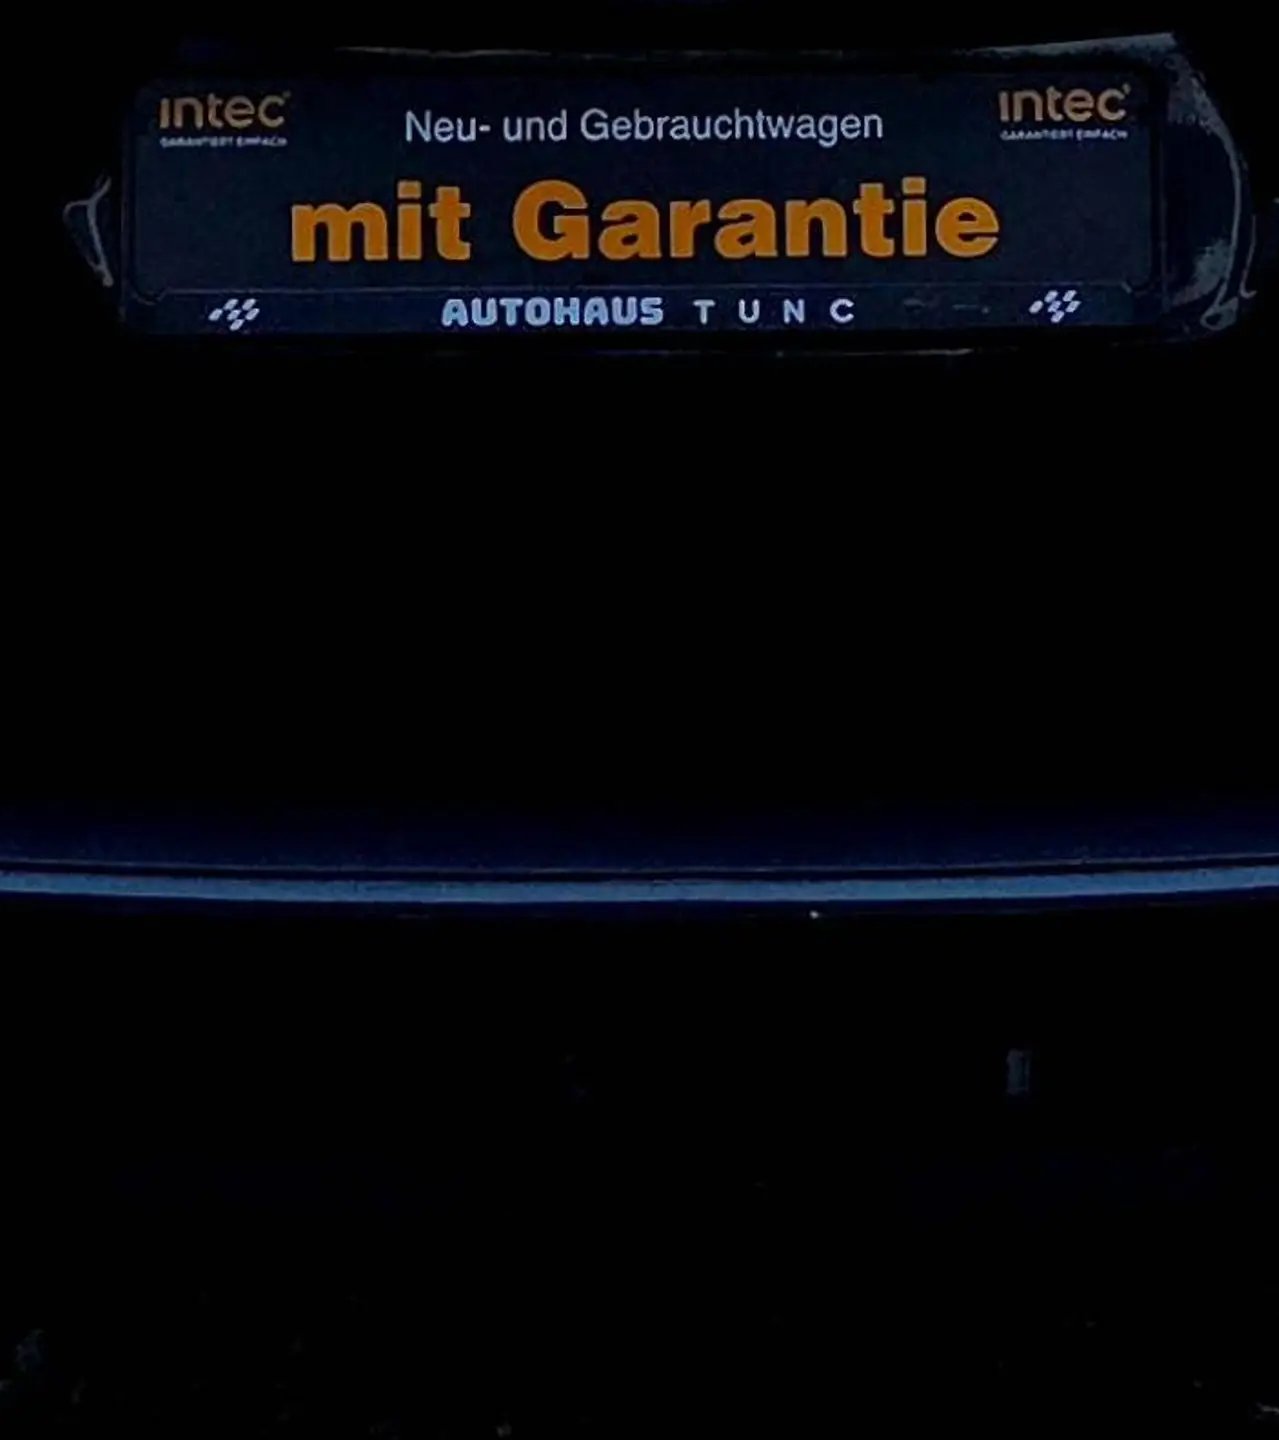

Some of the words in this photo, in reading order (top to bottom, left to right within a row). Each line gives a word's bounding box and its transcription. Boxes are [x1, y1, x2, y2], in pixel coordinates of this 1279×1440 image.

[159, 93, 287, 130] intec
[998, 85, 1127, 122] intec
[405, 110, 490, 142] Neu-
[503, 110, 568, 141] und
[580, 107, 884, 148] Gebrauchtwagen
[291, 179, 472, 262] mit
[512, 175, 1001, 261] Garantie
[440, 296, 665, 327] AUTOHAUS
